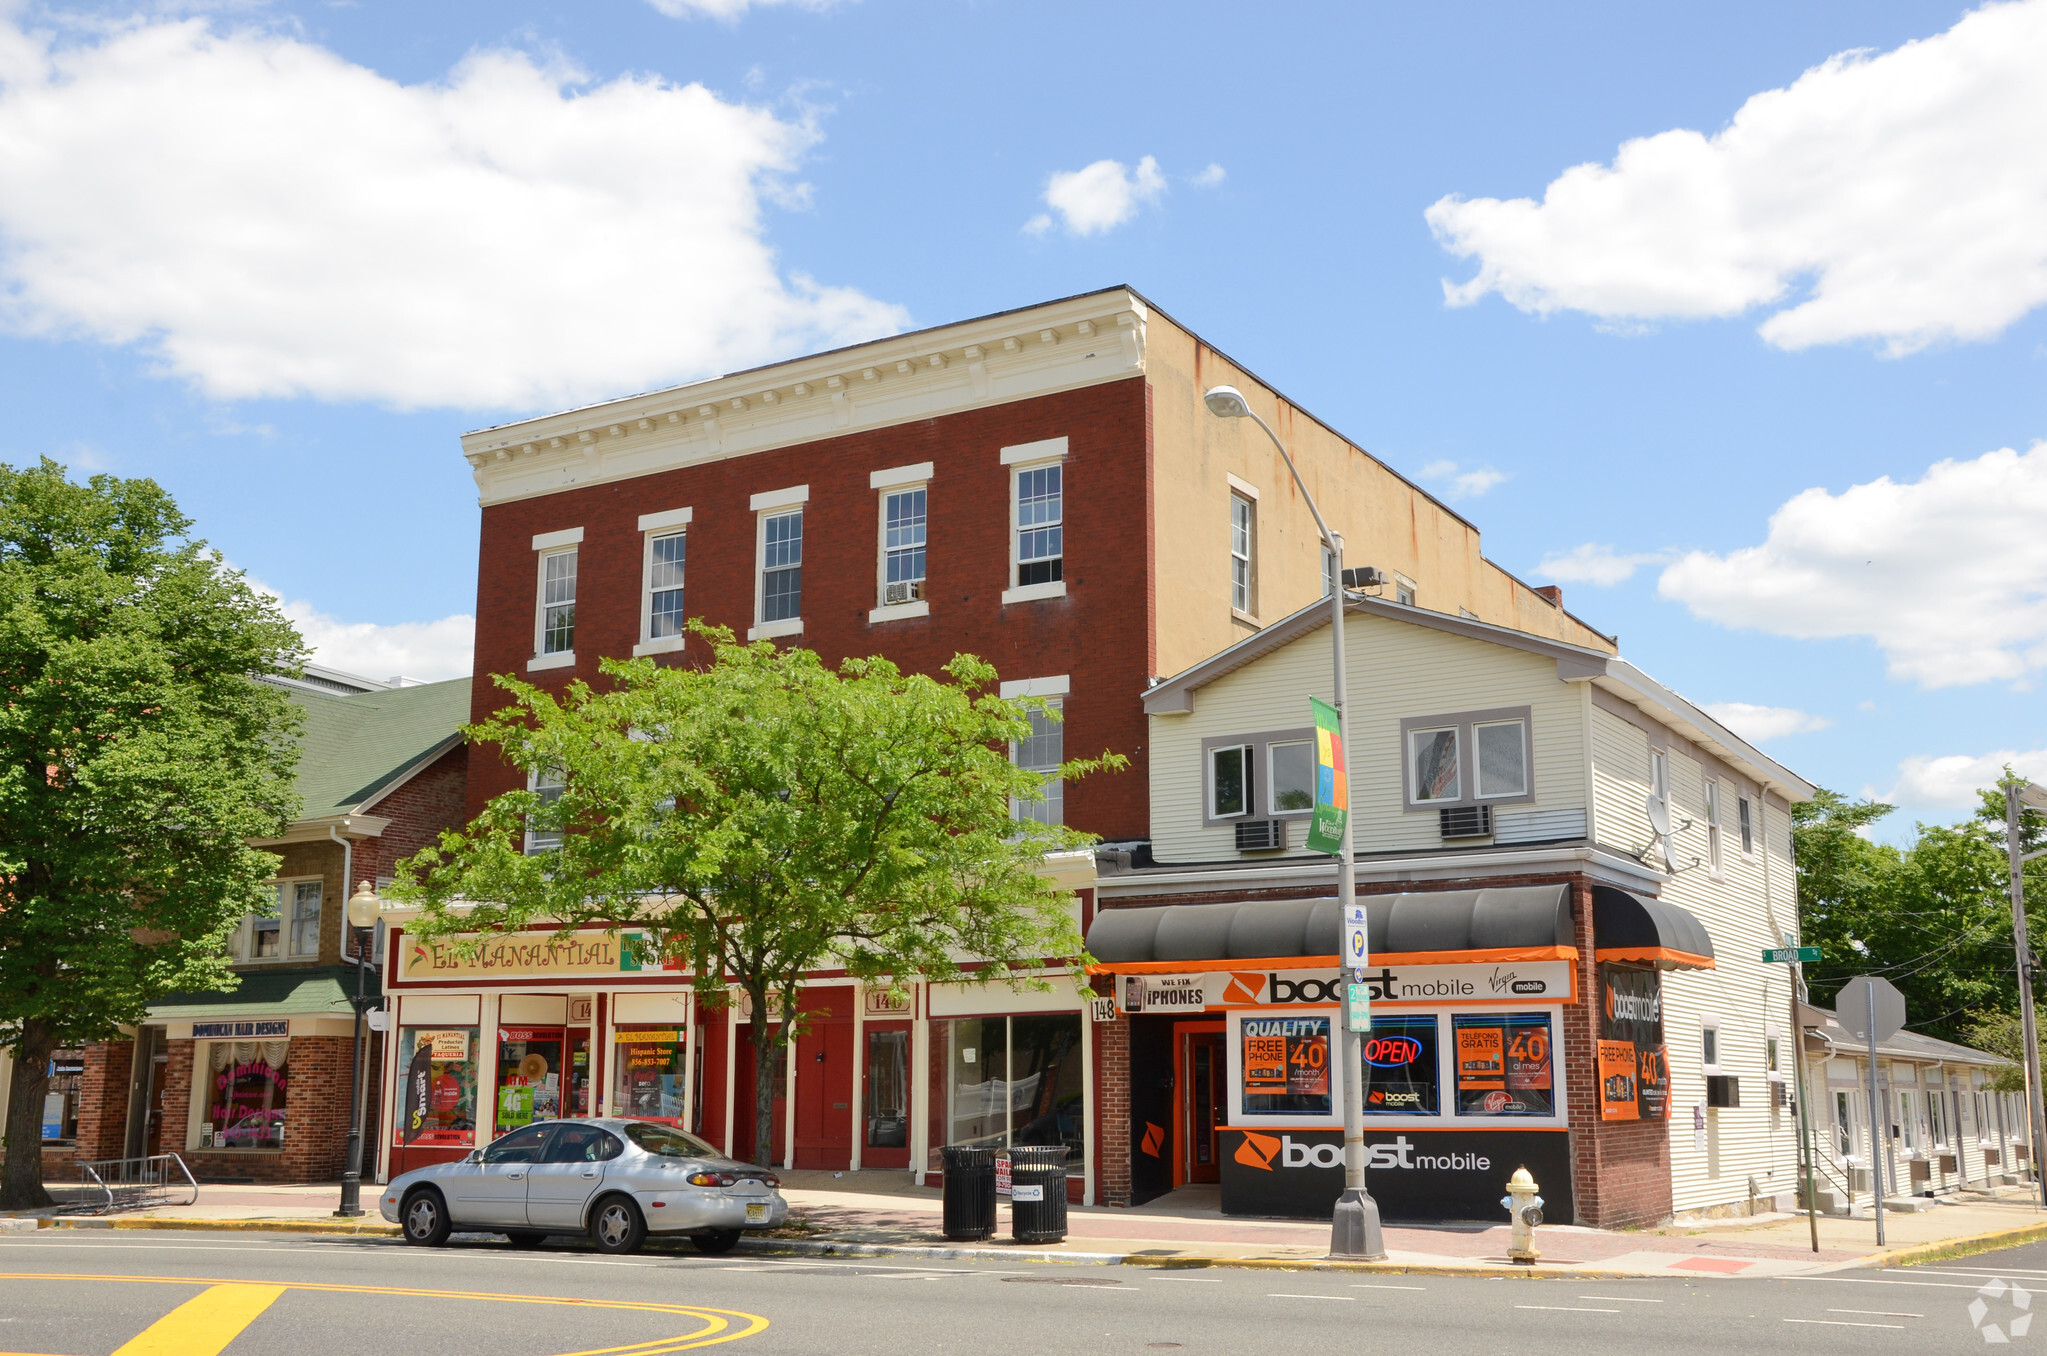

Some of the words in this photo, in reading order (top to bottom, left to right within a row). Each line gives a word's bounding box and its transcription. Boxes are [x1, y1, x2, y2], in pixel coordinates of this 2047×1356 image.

[432, 944, 458, 969] EL
[468, 940, 614, 969] MANANTIAL
[1772, 950, 1799, 961] BROAD
[1177, 978, 1191, 986] FIX
[1402, 977, 1475, 996] mobile
[1488, 966, 1517, 993] Virgin
[1515, 982, 1543, 991] mobile
[1147, 989, 1203, 1005] iPHONES
[1094, 1000, 1115, 1020] 148
[193, 1023, 233, 1037] DOMINICAN
[235, 1022, 254, 1036] HAIR
[256, 1021, 287, 1035] DESIGNS
[1246, 1020, 1322, 1037] QUALITY
[1248, 1040, 1283, 1052] FREE
[1364, 1039, 1417, 1063] OPEN
[1461, 1040, 1499, 1048] GRATIS
[630, 1048, 655, 1056] Hispanic
[1248, 1052, 1283, 1061] PHONE
[1601, 1046, 1615, 1062] FREE
[1616, 1048, 1634, 1063] PHONE
[631, 1058, 671, 1066] 856-853-7007
[1513, 1062, 1521, 1070] al
[217, 1060, 287, 1091] Dominican
[505, 1075, 528, 1086] ATM
[503, 1093, 521, 1111] 4G
[1385, 1092, 1420, 1102] boost
[212, 1103, 236, 1118] Hair
[516, 1112, 528, 1120] HERE
[1416, 1153, 1490, 1171] mobile
